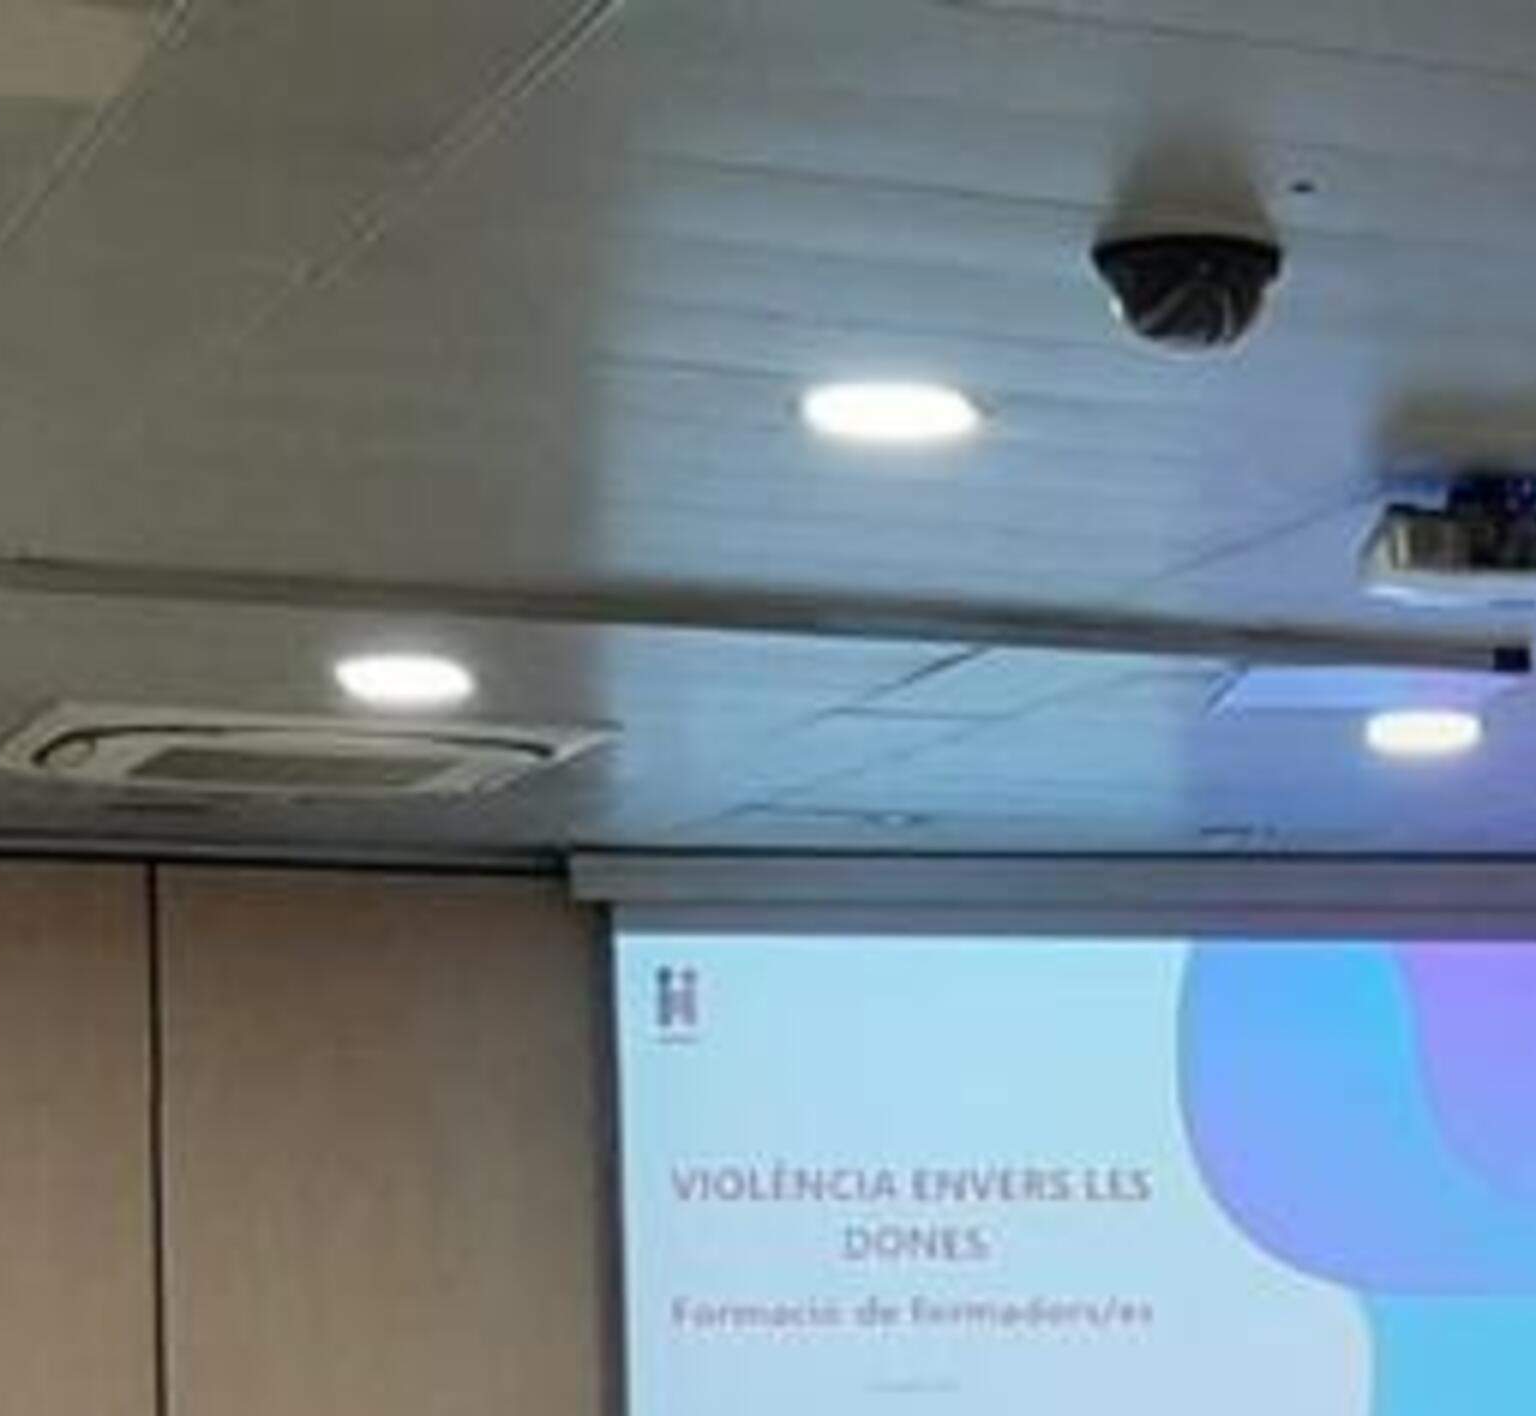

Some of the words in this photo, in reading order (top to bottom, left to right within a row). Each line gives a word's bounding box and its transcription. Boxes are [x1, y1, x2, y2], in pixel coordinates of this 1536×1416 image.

[911, 1167, 1071, 1202] ENVERS
[1084, 1167, 1154, 1202] LES
[843, 1223, 992, 1261] DONES
[855, 1294, 899, 1327] de
